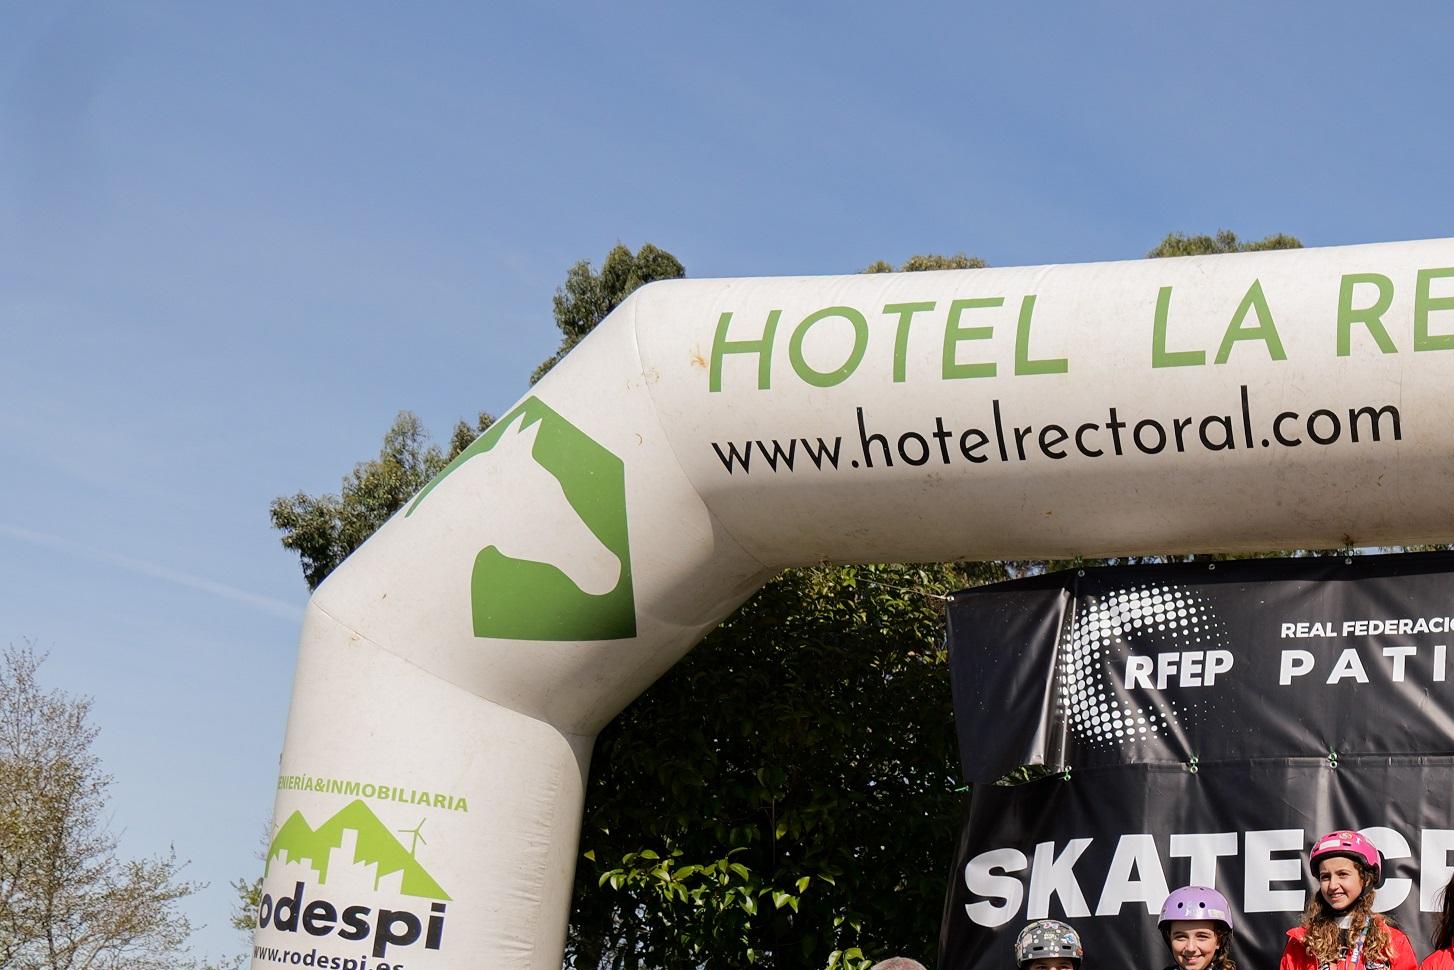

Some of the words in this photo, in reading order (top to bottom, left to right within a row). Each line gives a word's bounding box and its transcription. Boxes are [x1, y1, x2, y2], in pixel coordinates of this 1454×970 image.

[709, 294, 1069, 393] HOTEL
[1151, 278, 1287, 369] LA
[711, 385, 1402, 475] www.hotelrectoral.com
[1280, 621, 1337, 639] REAL
[1124, 650, 1234, 691] RFEP
[278, 773, 468, 812] ENIERÍA&INMOBILIARIA
[964, 830, 1307, 929] SKATE
[260, 881, 447, 958] odespi
